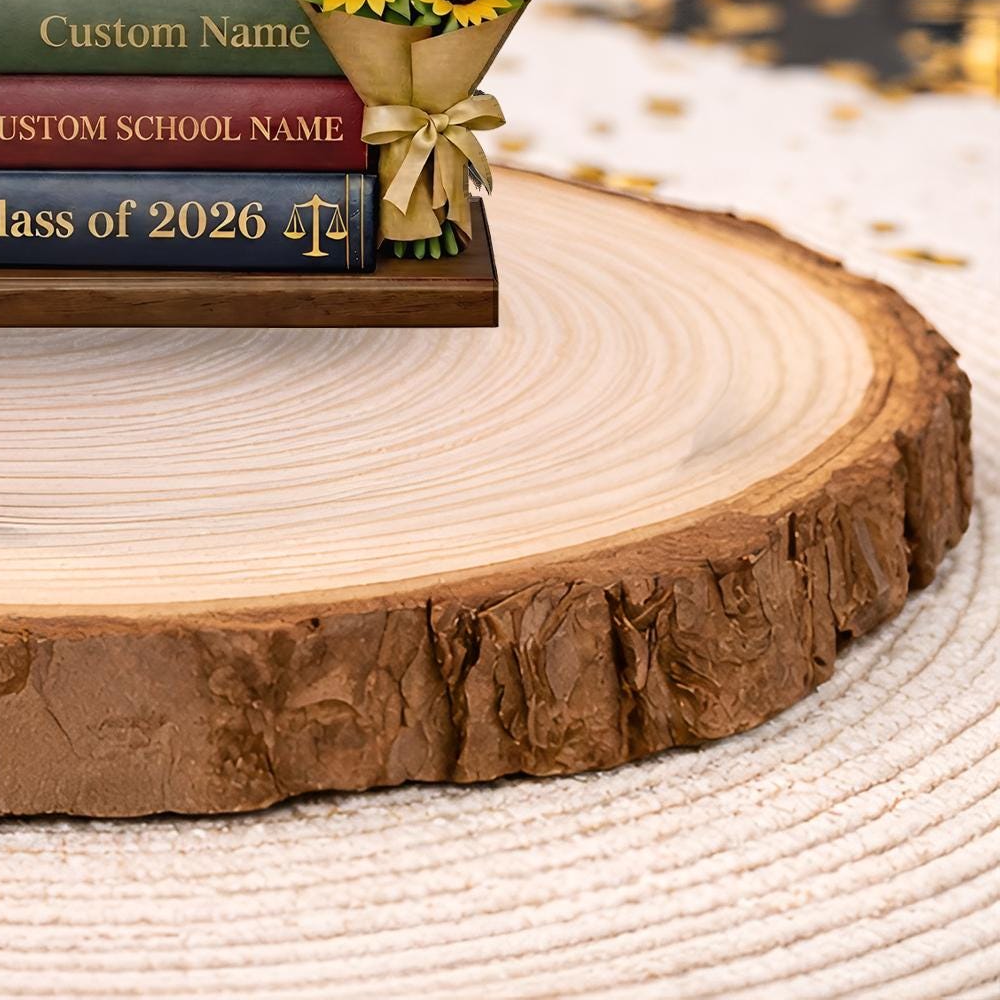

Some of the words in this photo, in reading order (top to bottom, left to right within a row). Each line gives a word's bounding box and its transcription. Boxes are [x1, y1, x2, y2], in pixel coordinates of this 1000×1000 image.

[39, 14, 188, 49] Custom
[199, 15, 311, 49] Name
[116, 114, 242, 142] SCHOOL
[249, 115, 345, 142] NAME
[87, 199, 138, 239] of
[148, 201, 267, 240] 2026
